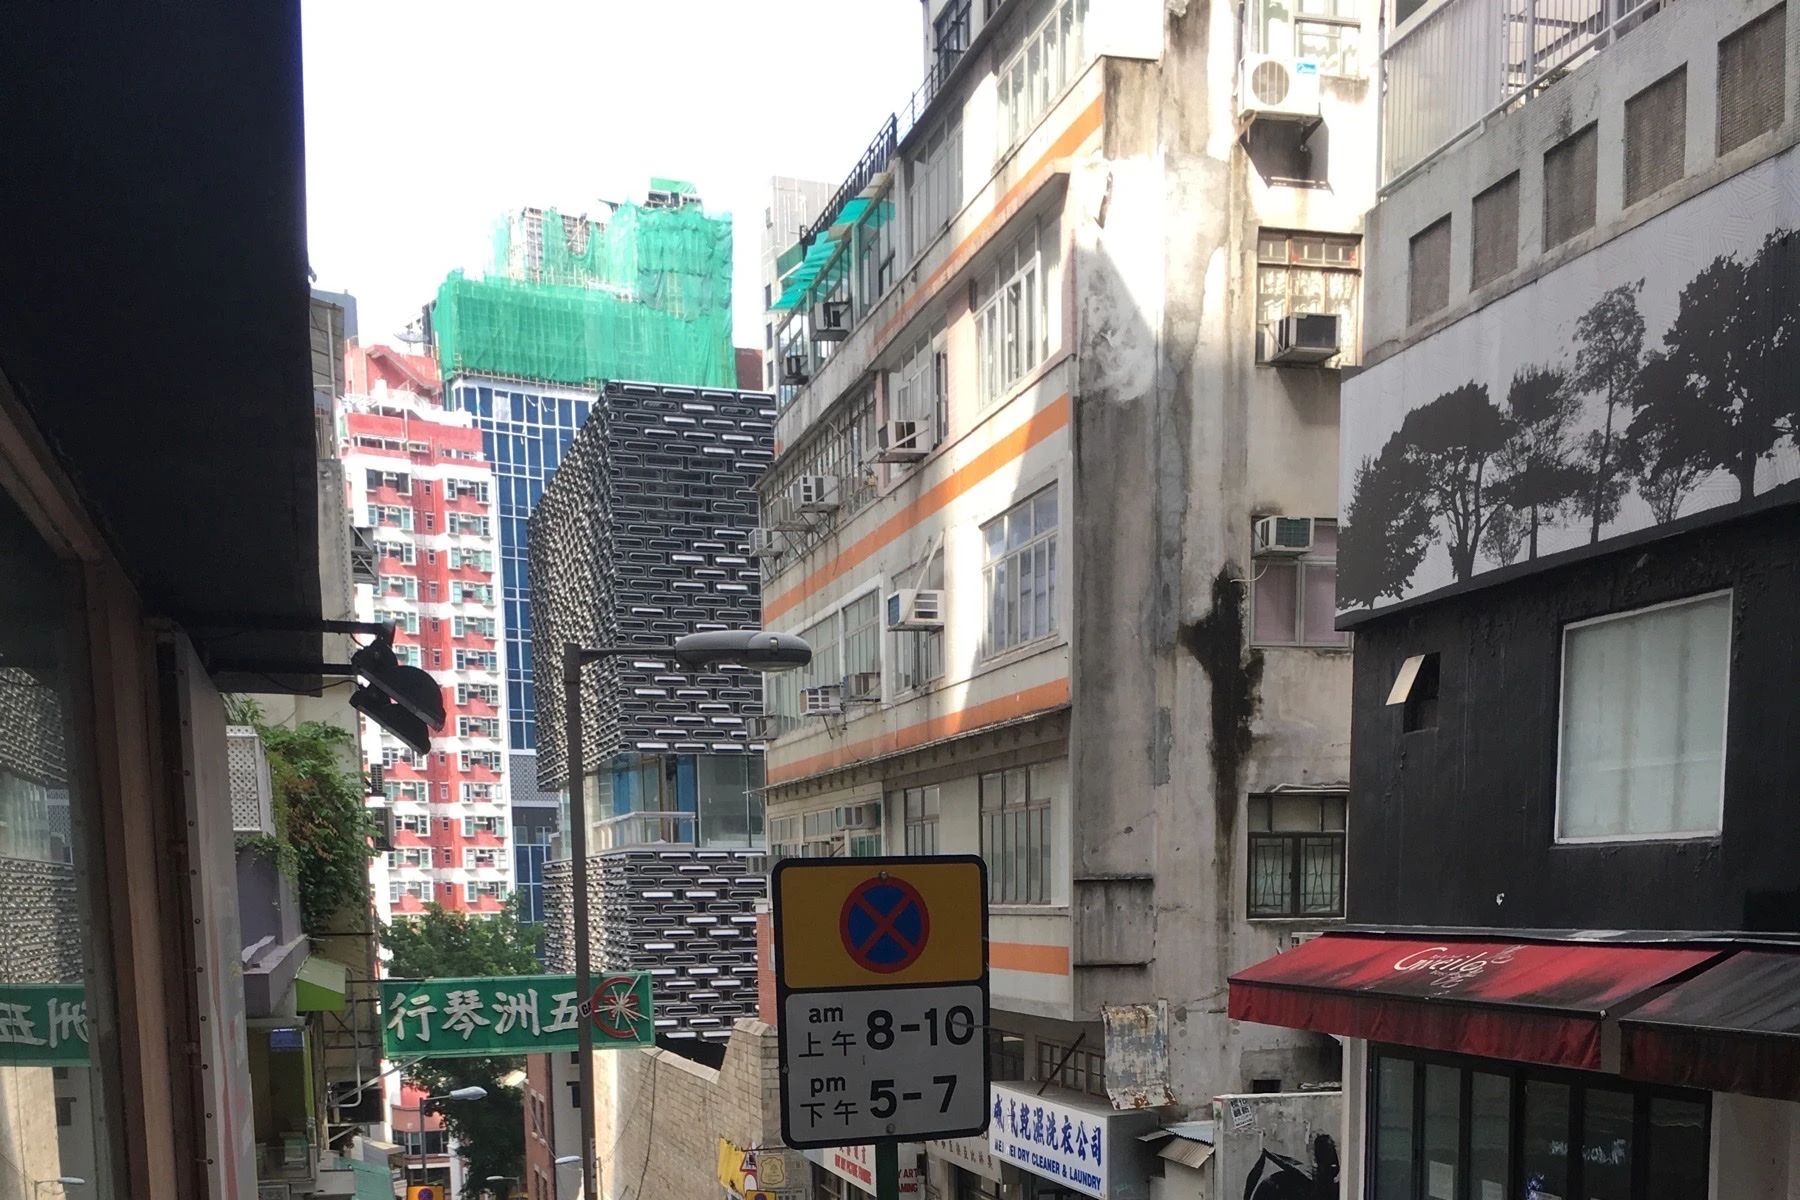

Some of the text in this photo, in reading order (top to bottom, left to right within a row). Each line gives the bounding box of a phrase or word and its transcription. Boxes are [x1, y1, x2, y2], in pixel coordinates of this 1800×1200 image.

[808, 1005, 975, 1051] am 8-10
[798, 1030, 857, 1058] 上午
[810, 1075, 846, 1097] pm
[800, 1099, 858, 1128] 下午
[1017, 1147, 1030, 1162] DRY
[1031, 1152, 1060, 1175] CLEANER
[1062, 1164, 1068, 1178] &
[1069, 1167, 1102, 1191] LAUNDRY
